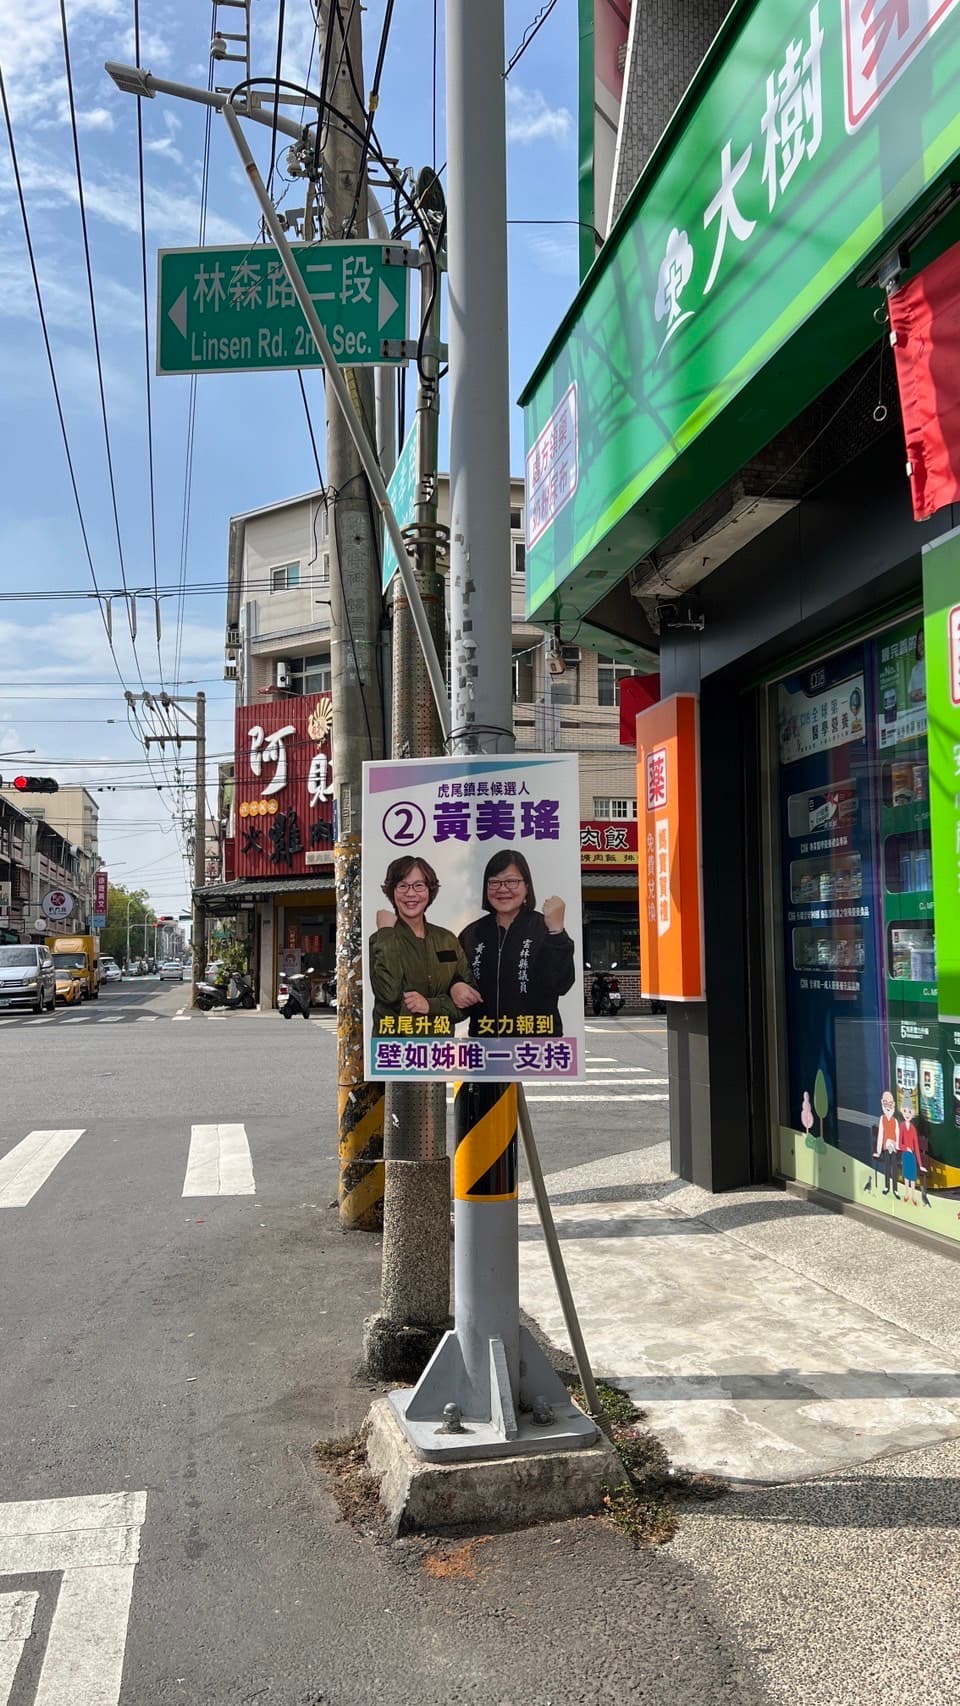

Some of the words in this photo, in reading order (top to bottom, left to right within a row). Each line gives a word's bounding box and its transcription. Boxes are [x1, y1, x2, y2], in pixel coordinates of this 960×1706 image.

[702, 1, 824, 295] 大樹
[193, 256, 374, 313] 林森路二段
[192, 332, 251, 361] Linsen
[259, 328, 287, 357] Rd.
[294, 324, 327, 355] 2n
[332, 324, 372, 355] Sec.
[438, 781, 530, 798] 虎尾鎮長候選人
[433, 799, 560, 843] 黃美瑤
[580, 825, 629, 850] 肉飯
[378, 1015, 451, 1035] 虎尾升級
[477, 1014, 555, 1035] 女力報到
[376, 1042, 572, 1070] 壁如姊唯一支持
